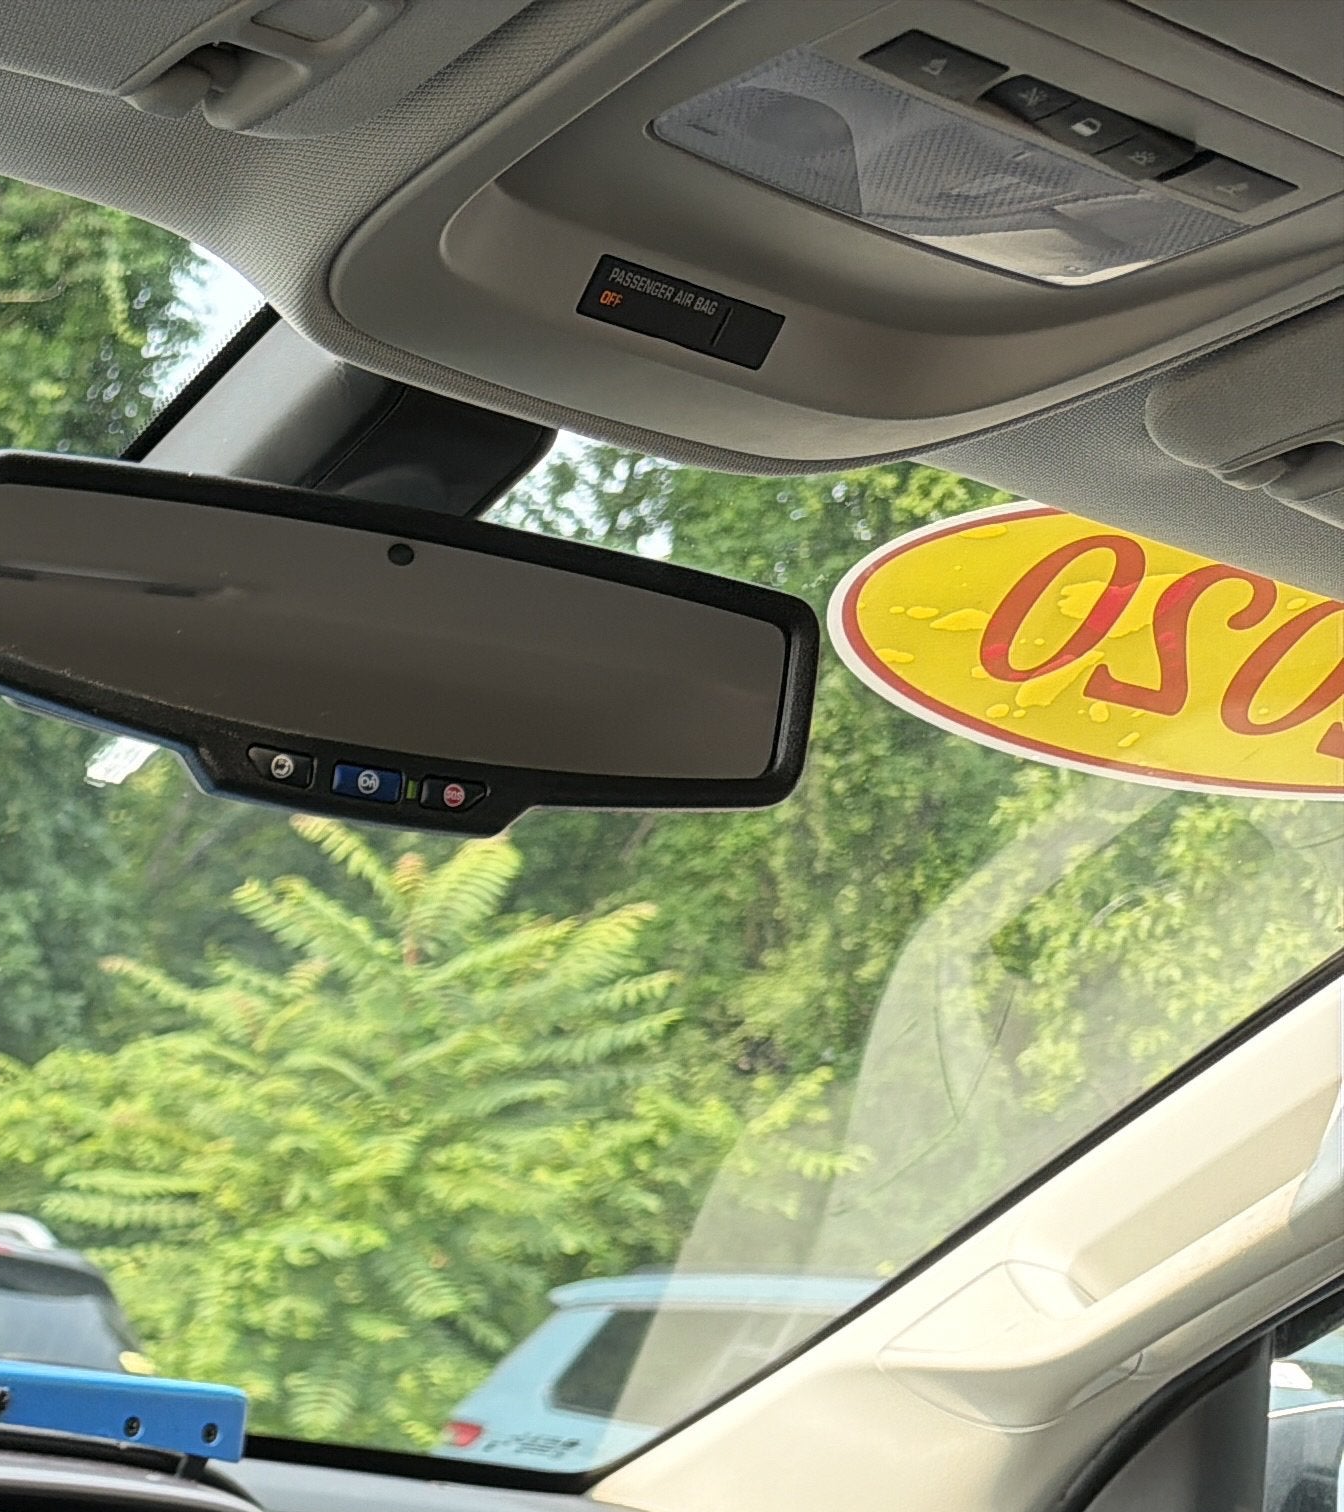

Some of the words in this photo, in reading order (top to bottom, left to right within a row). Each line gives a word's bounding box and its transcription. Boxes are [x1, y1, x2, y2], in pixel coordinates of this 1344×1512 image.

[599, 290, 623, 307] OFF
[609, 267, 674, 301] PASSENGER
[674, 291, 695, 308] AIR
[694, 297, 718, 316] BAG
[446, 788, 463, 802] SOS
